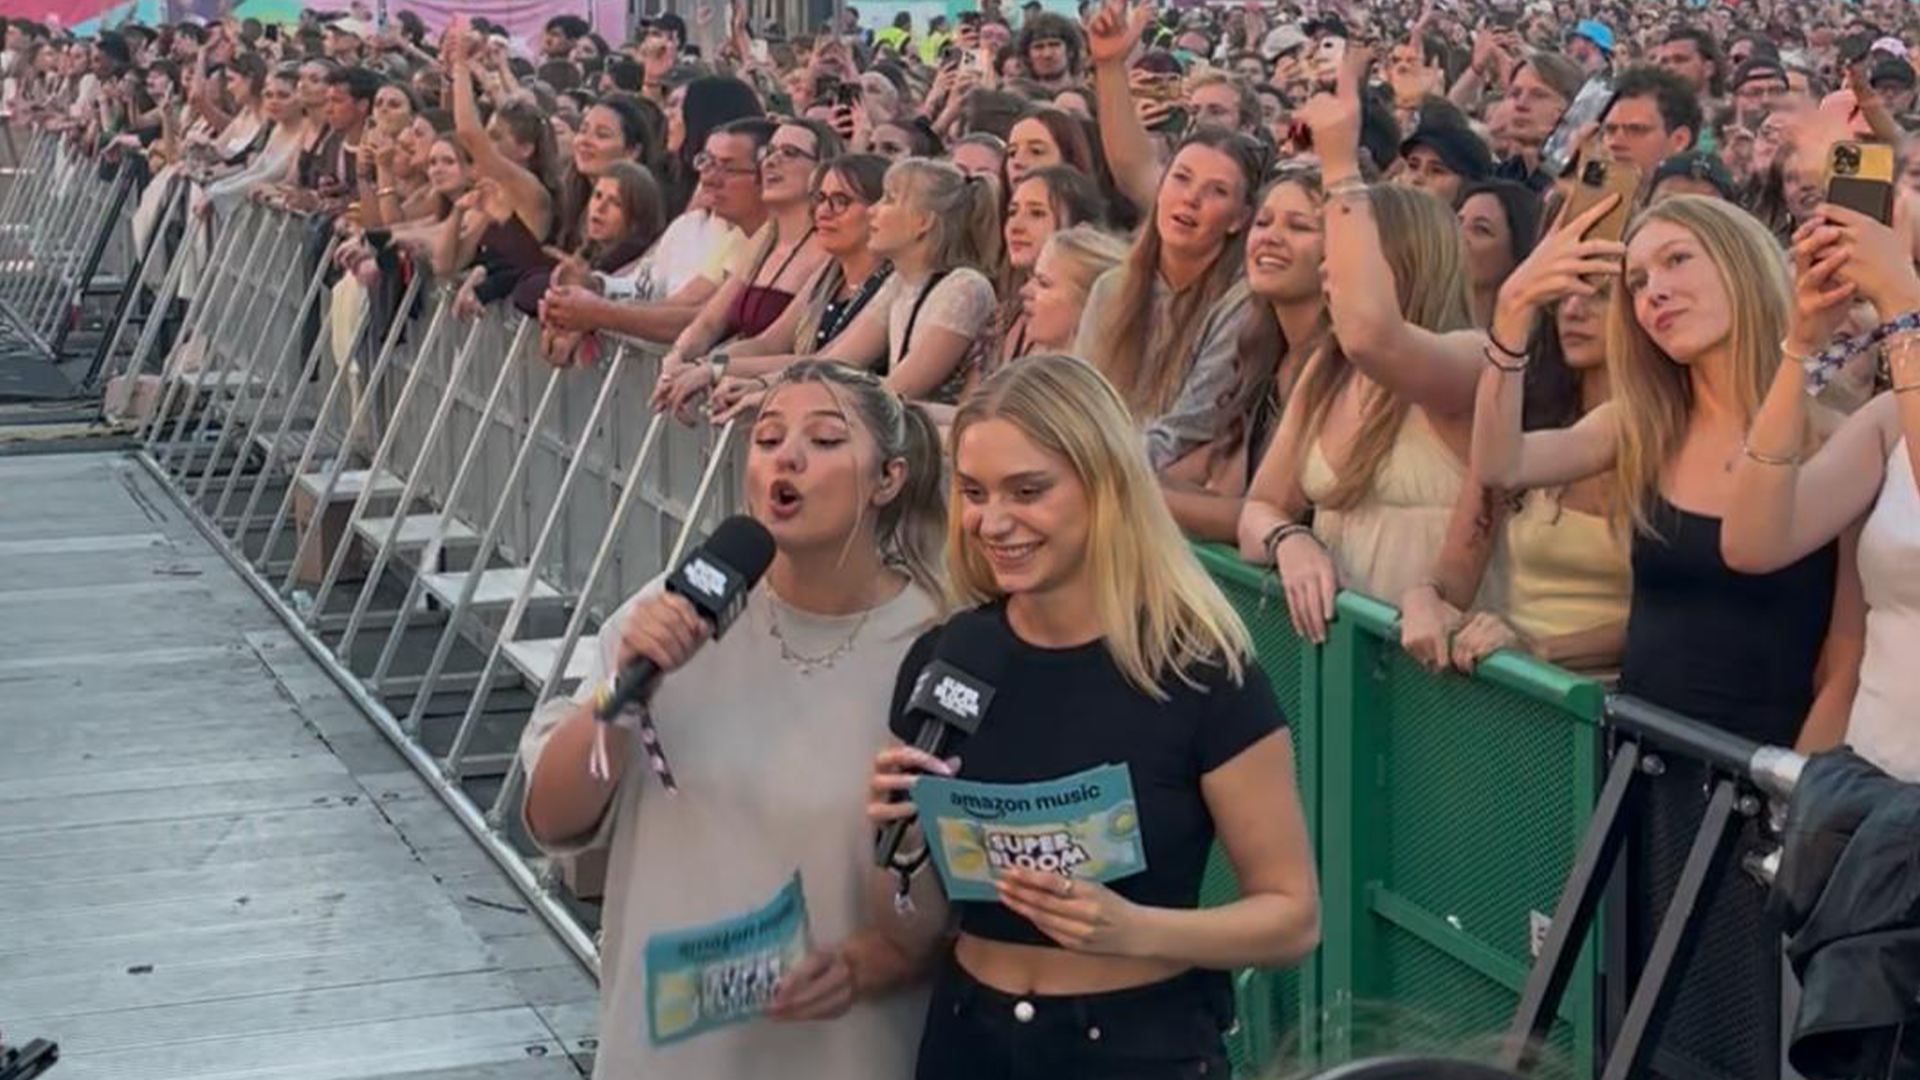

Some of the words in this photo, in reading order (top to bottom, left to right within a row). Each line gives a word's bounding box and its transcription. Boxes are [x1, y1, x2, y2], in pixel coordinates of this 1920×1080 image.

[951, 790, 1031, 815] amazon
[1036, 783, 1101, 811] music
[991, 833, 1072, 854] SUPER
[990, 847, 1087, 872] BLOOM
